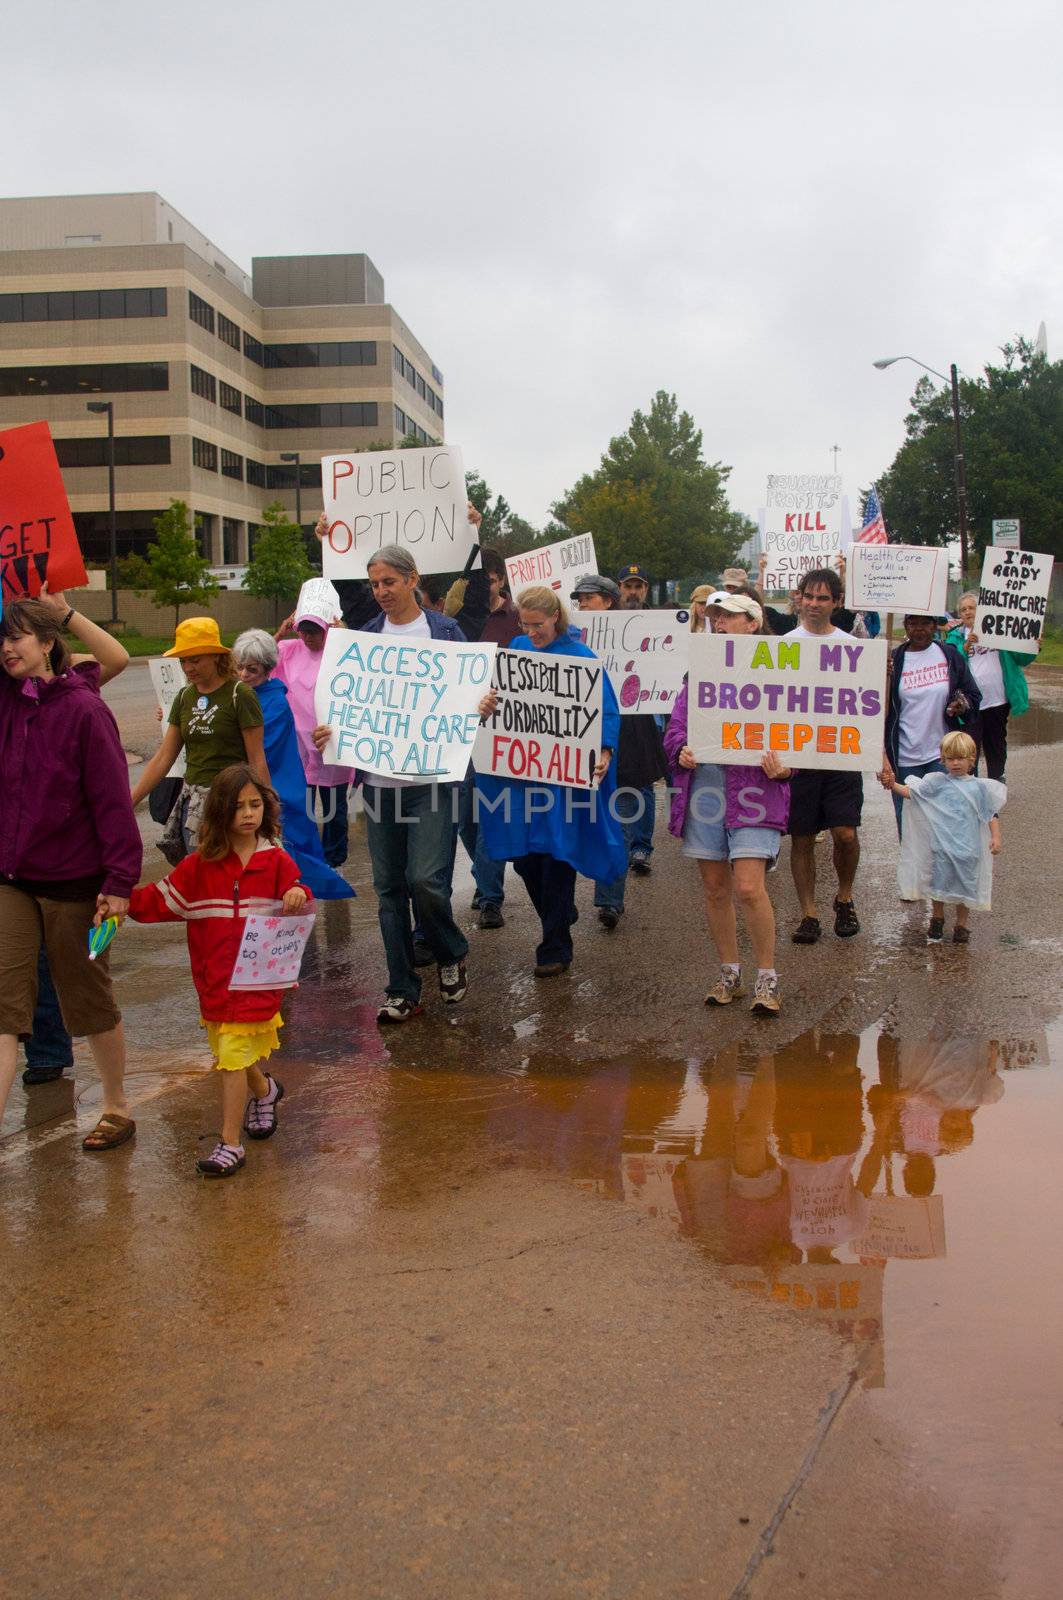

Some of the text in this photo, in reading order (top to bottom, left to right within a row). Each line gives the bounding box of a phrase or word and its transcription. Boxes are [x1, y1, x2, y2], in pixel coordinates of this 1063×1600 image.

[332, 453, 450, 500] PUBLIC
[329, 504, 455, 553] OPTION
[785, 511, 826, 532] KILL
[766, 532, 840, 552] PEOPLE!
[860, 548, 922, 562] Health Care
[1004, 551, 1034, 565] I'M
[508, 550, 552, 586] PROFITS
[560, 537, 591, 569] DEATH
[775, 555, 831, 571] SUPPORT
[993, 564, 1040, 580] READY
[978, 587, 1047, 616] HEALTHCARE
[1005, 580, 1026, 591] for
[622, 615, 675, 653] Care
[981, 614, 1041, 640] REFORM
[336, 641, 488, 686] ACCESS TO
[725, 640, 864, 673] I AM MY
[330, 672, 448, 712] QUALITY
[698, 681, 881, 716] BROTHER'S
[327, 701, 481, 744] HEALTH CARE
[722, 722, 861, 754] KEEPER
[337, 730, 449, 774] FOR ALL
[491, 735, 596, 788] FOR ALL!
[242, 948, 257, 959] to
